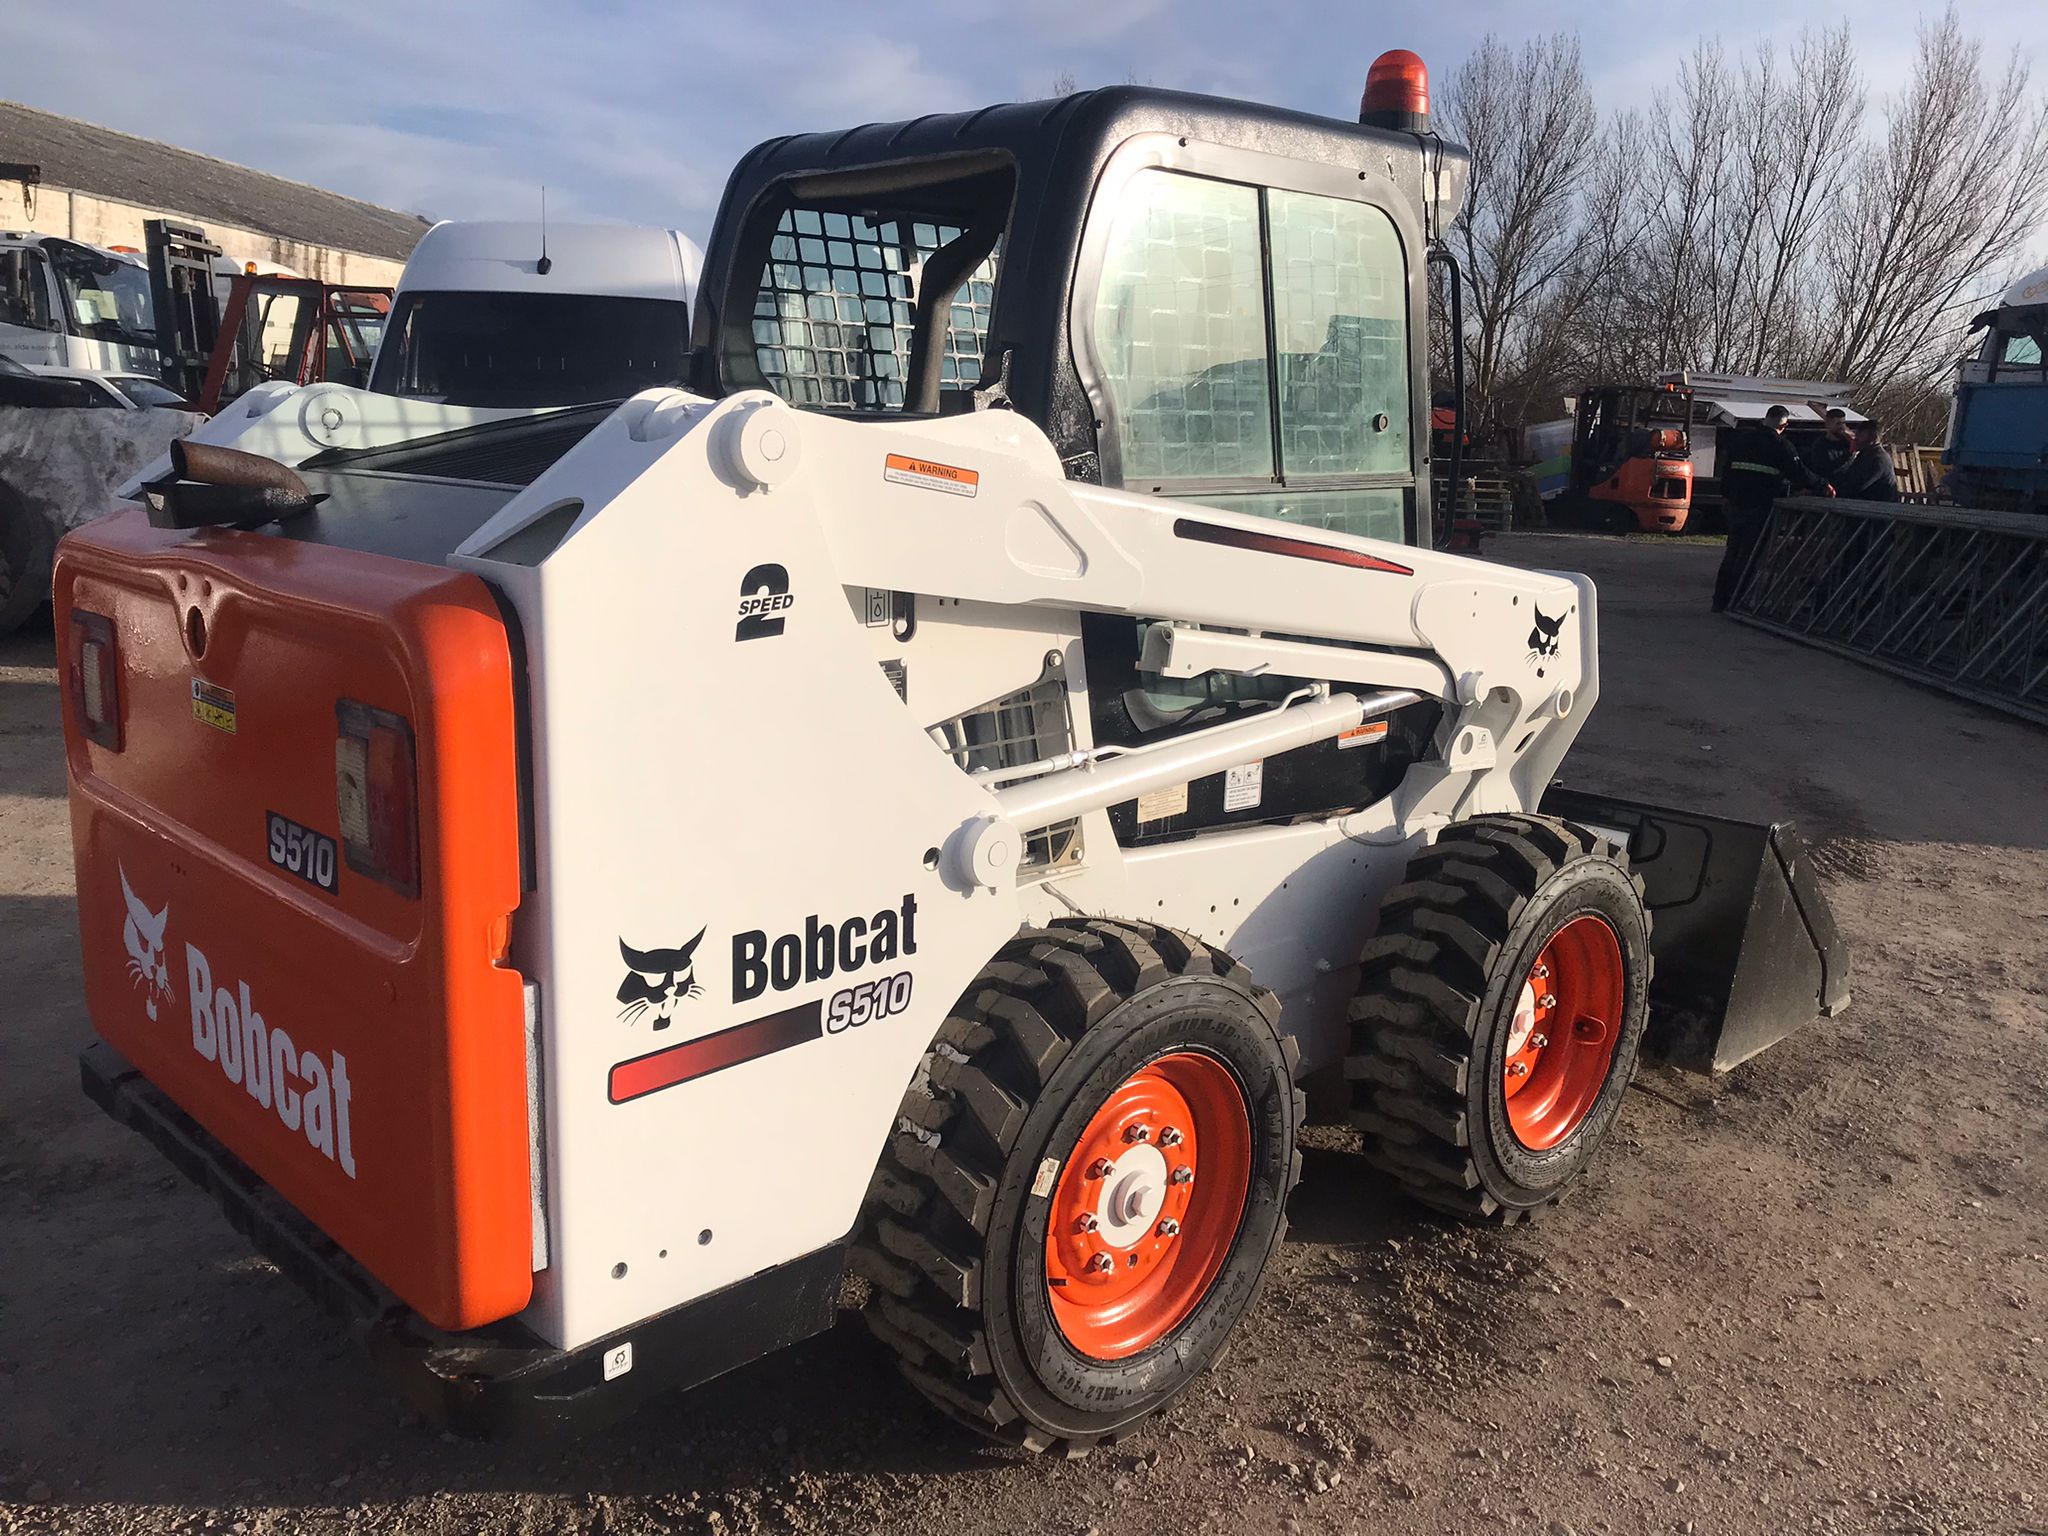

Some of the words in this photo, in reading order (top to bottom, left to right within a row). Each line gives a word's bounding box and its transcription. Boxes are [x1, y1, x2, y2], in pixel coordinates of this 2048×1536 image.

[919, 463, 958, 479] WARNING
[735, 563, 789, 642] 2
[738, 594, 794, 616] SPEED
[270, 816, 334, 888] S510
[732, 893, 917, 1005] Bobcat
[827, 971, 913, 1035] S510
[185, 941, 355, 1179] Bobcat
